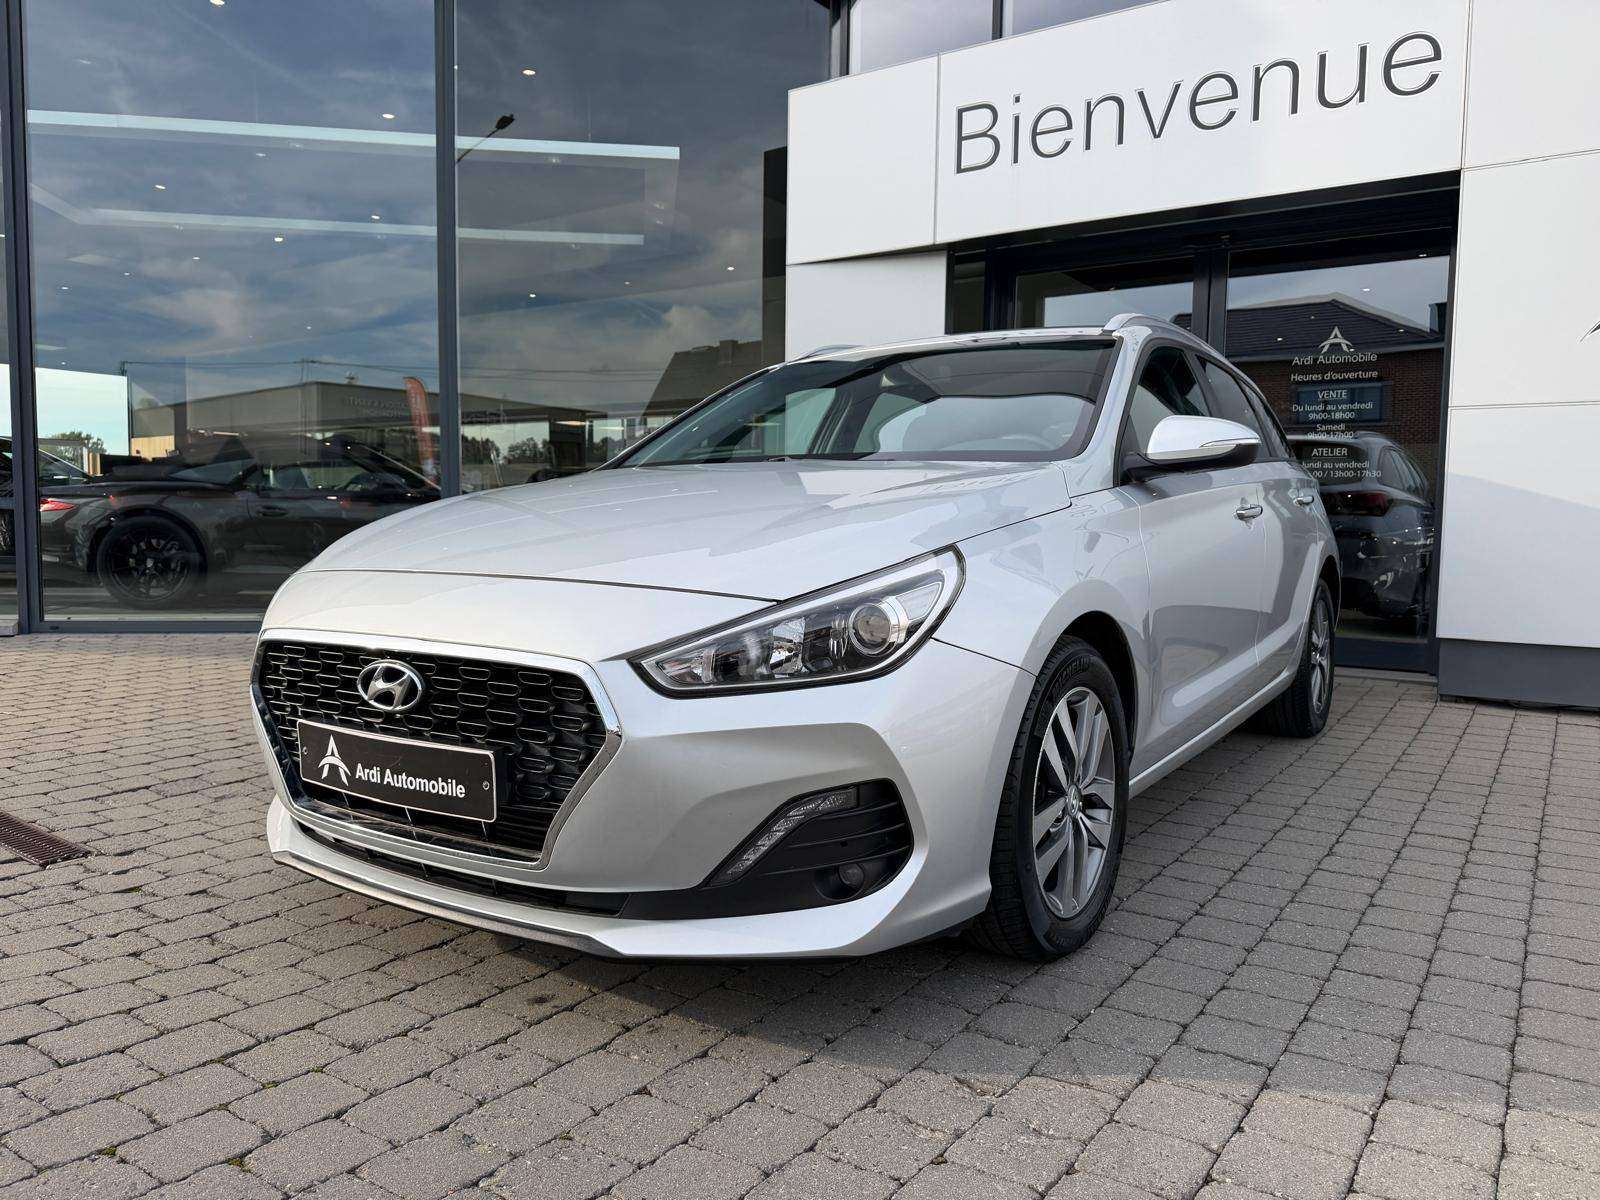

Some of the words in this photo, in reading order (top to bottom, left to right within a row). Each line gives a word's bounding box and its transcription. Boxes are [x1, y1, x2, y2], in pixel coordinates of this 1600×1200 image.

[955, 30, 1443, 174] Bienvenue
[1292, 356, 1313, 366] Ardi
[1317, 352, 1378, 364] Automobile
[1290, 373, 1322, 382] Heures
[1324, 370, 1378, 380] d'ouverture
[1317, 389, 1348, 399] VENTE
[1292, 404, 1303, 412] Du
[1305, 403, 1324, 411] lundi
[1338, 402, 1373, 410] vendredi
[1308, 411, 1355, 420] 9h00-18h00
[1316, 423, 1345, 431] Samedi
[1311, 447, 1348, 457] ATELIER
[1335, 460, 1370, 469] vendredi
[355, 763, 380, 784] Ardi
[384, 768, 466, 798] Automobile
